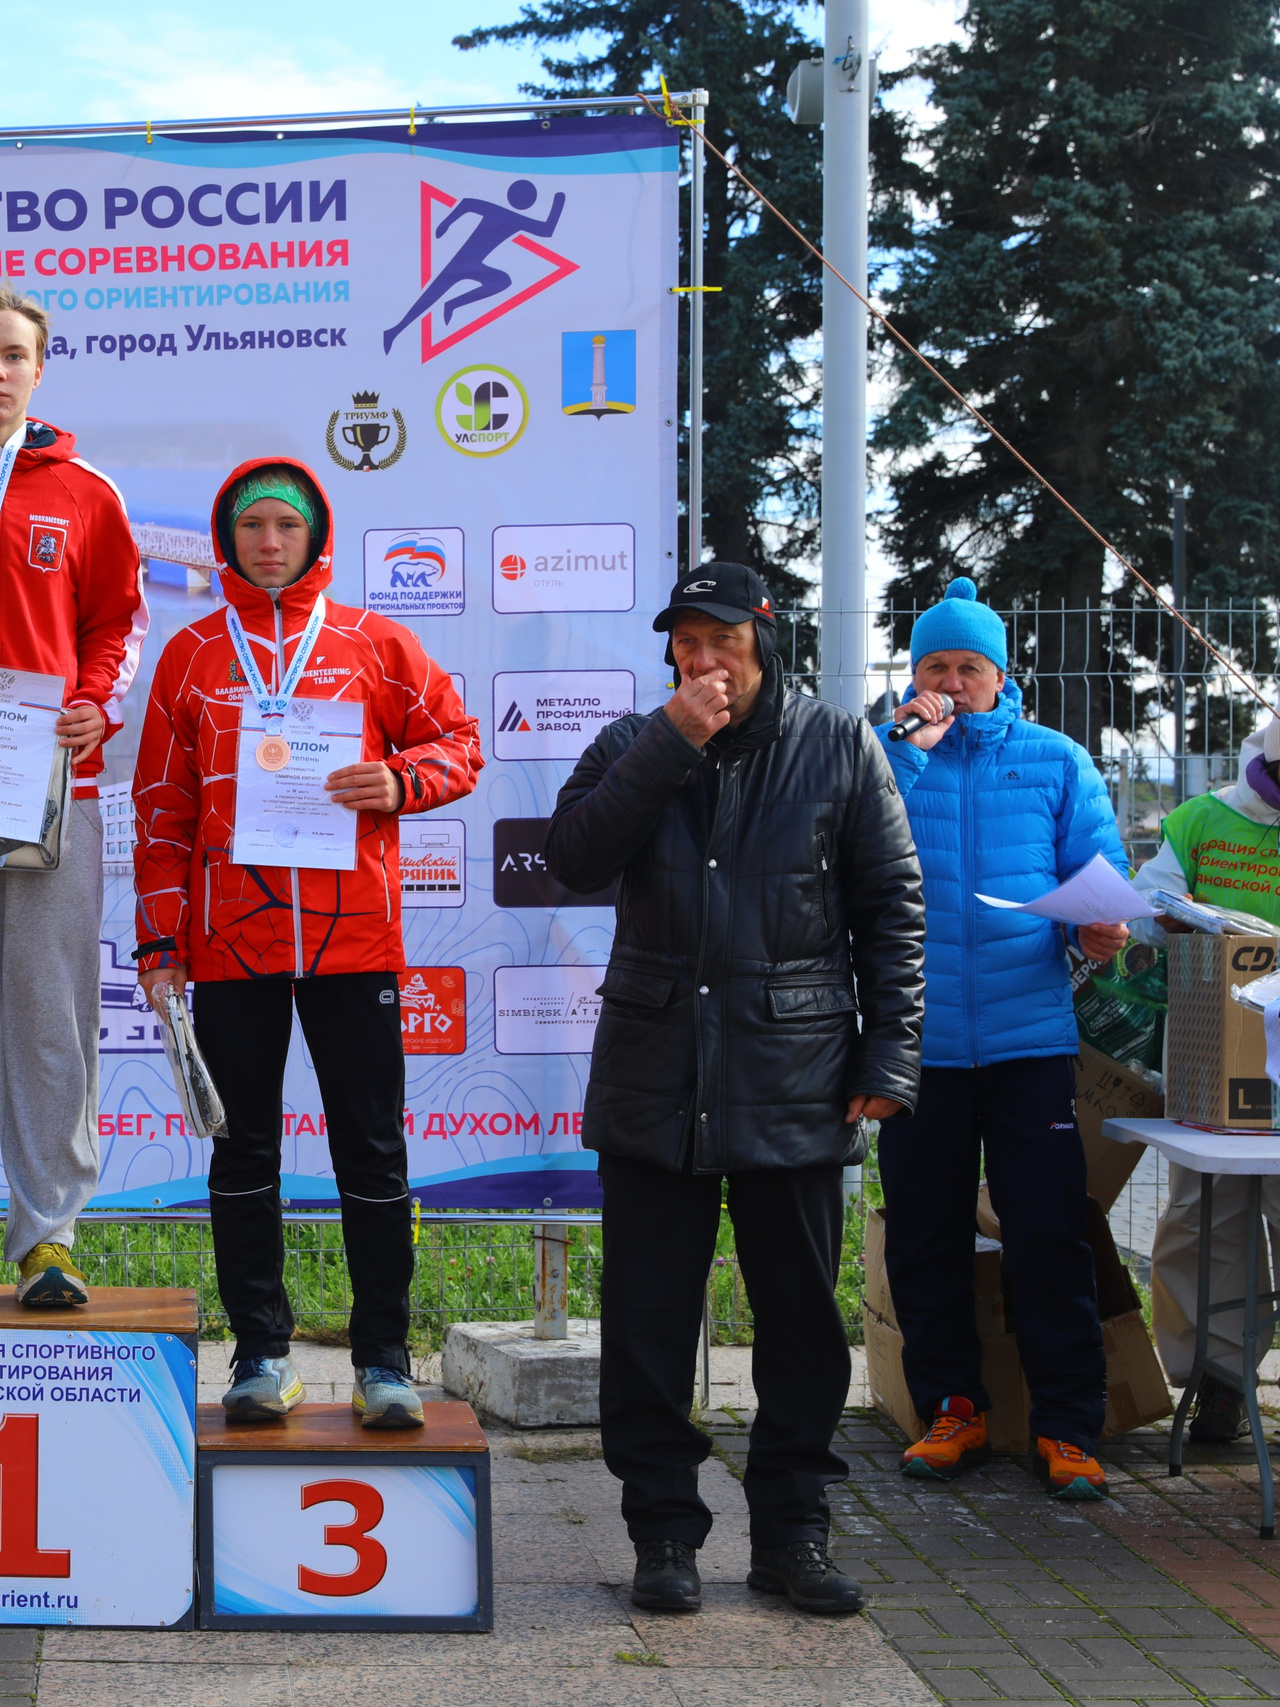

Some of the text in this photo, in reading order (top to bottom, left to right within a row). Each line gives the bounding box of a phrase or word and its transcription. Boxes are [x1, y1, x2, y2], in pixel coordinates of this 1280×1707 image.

[103, 179, 347, 230] РОССИИ
[34, 239, 350, 276] СОРЕВНОВАНИЯ
[84, 280, 350, 310] ОРИЕНТИРОВАНИЯ
[86, 333, 177, 361] город
[184, 324, 347, 351] Ульяновск
[343, 411, 389, 421] ТРИУМФ
[455, 432, 510, 444] УЛСПОРТ
[0, 462, 9, 487] СПОРТА
[29, 514, 70, 527] МОСКОМСПОРТ
[534, 549, 628, 573] azimut
[534, 579, 564, 587] ОТЕЛЬ
[369, 590, 462, 601] ФОНД ПОДДЕРЖКИ
[368, 602, 464, 611] РЕГИОНАЛЬНЫХ ПРОЕКТОВ
[231, 617, 263, 695] МИНИСТЕРСТВО СПОРТА РОССИИ
[283, 615, 320, 695] МИНИСТЕРСТВО СПОРТА РОССИИ
[302, 667, 351, 679] RIENTEERING
[313, 676, 336, 685] TEAM
[536, 698, 601, 707] МЕТАЛЛО
[536, 707, 632, 719] ПРОФИЛЬНЫЙ
[536, 722, 582, 732] ЗАВОД
[288, 741, 330, 753] ПЛОМ
[500, 852, 547, 872] ARS
[1191, 848, 1280, 877] ориентиро
[400, 869, 457, 880] РЯНИК
[1196, 874, 1272, 894] яновской
[1232, 946, 1280, 972] CD
[1238, 1088, 1251, 1110] L
[98, 1113, 156, 1140] БЕГ,
[423, 1112, 539, 1140] ДУХОМ
[548, 1112, 584, 1135] ЛЕ
[11, 1343, 156, 1361] СПОРТИВНОГО
[50, 1386, 141, 1403] ОБЛАСТИ
[297, 1478, 388, 1597] 3
